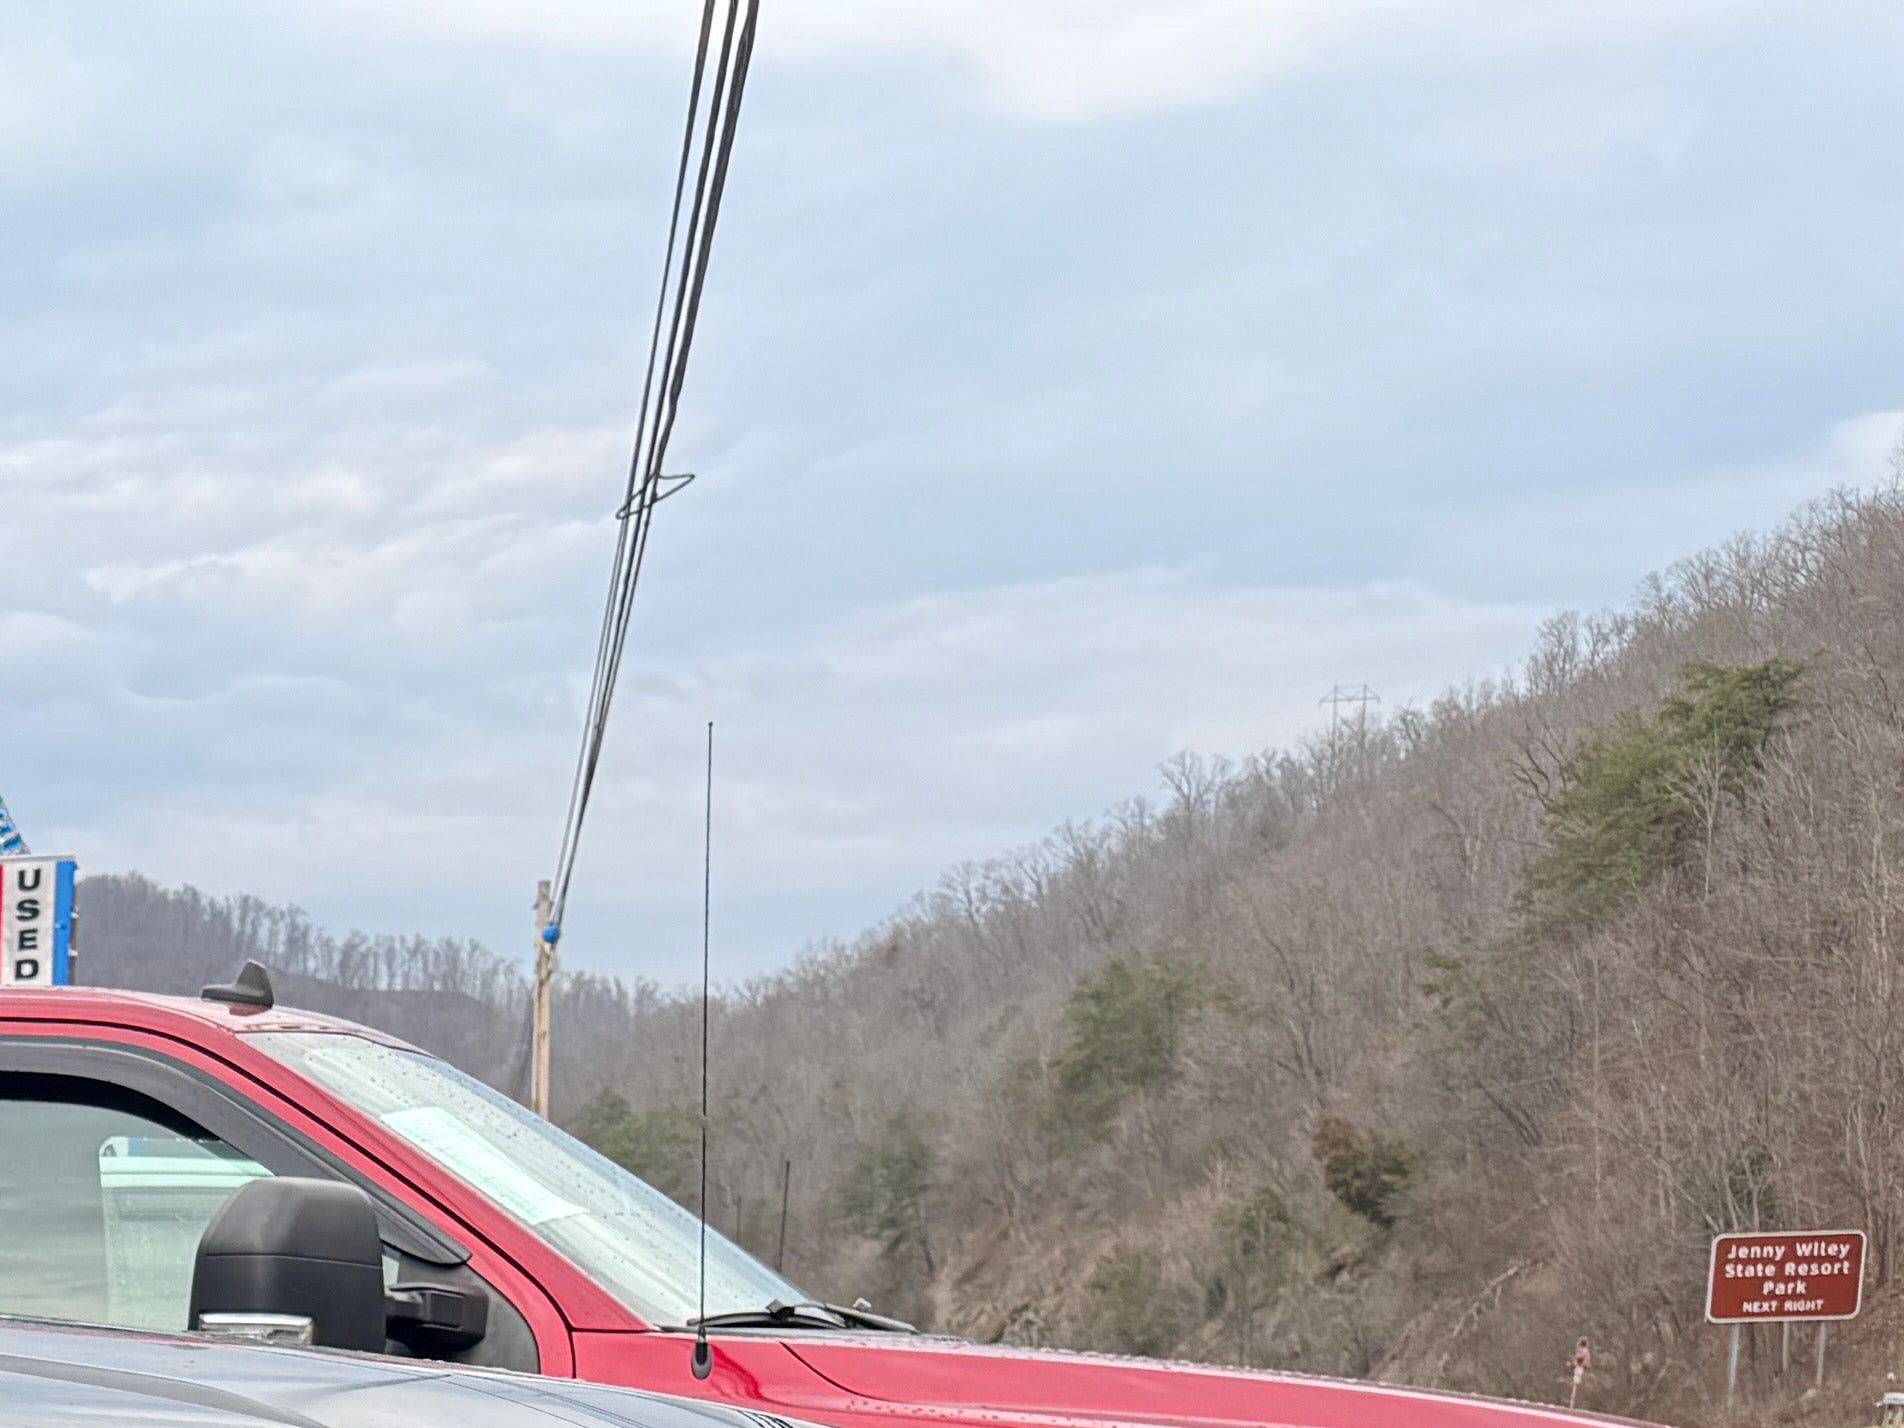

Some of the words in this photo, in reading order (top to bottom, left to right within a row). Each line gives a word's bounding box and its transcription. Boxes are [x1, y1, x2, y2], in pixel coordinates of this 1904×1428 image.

[14, 868, 41, 981] USED
[1727, 1243, 1785, 1261] Jenny
[1795, 1241, 1850, 1258] Wiley
[1724, 1262, 1775, 1278] State
[1784, 1260, 1850, 1276] Resort
[1762, 1279, 1807, 1296] Park
[1742, 1301, 1778, 1313] NEXT
[1784, 1299, 1824, 1312] RIGHT
